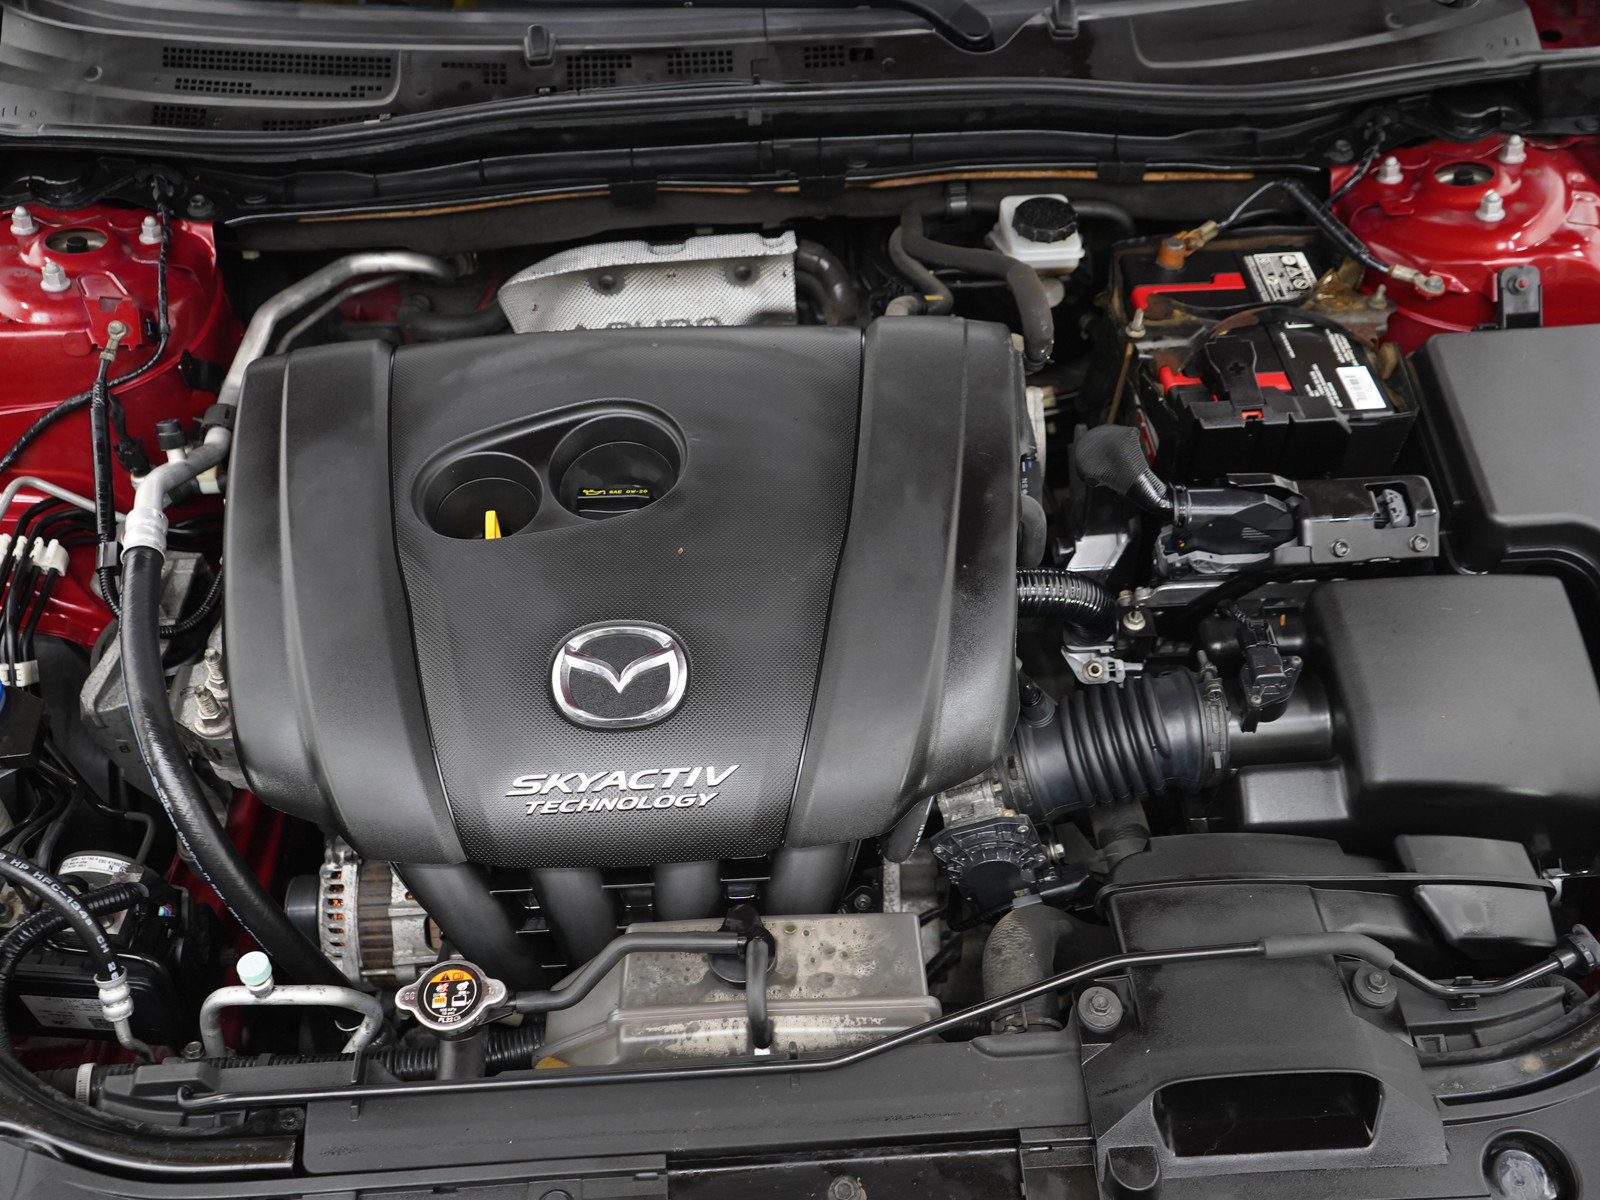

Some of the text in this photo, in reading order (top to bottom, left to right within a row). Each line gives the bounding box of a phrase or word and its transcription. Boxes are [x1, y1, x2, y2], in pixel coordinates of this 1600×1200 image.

[505, 764, 741, 798] SKYACTIV
[524, 792, 721, 816] TECHNOLOGY
[10, 858, 30, 870] HP
